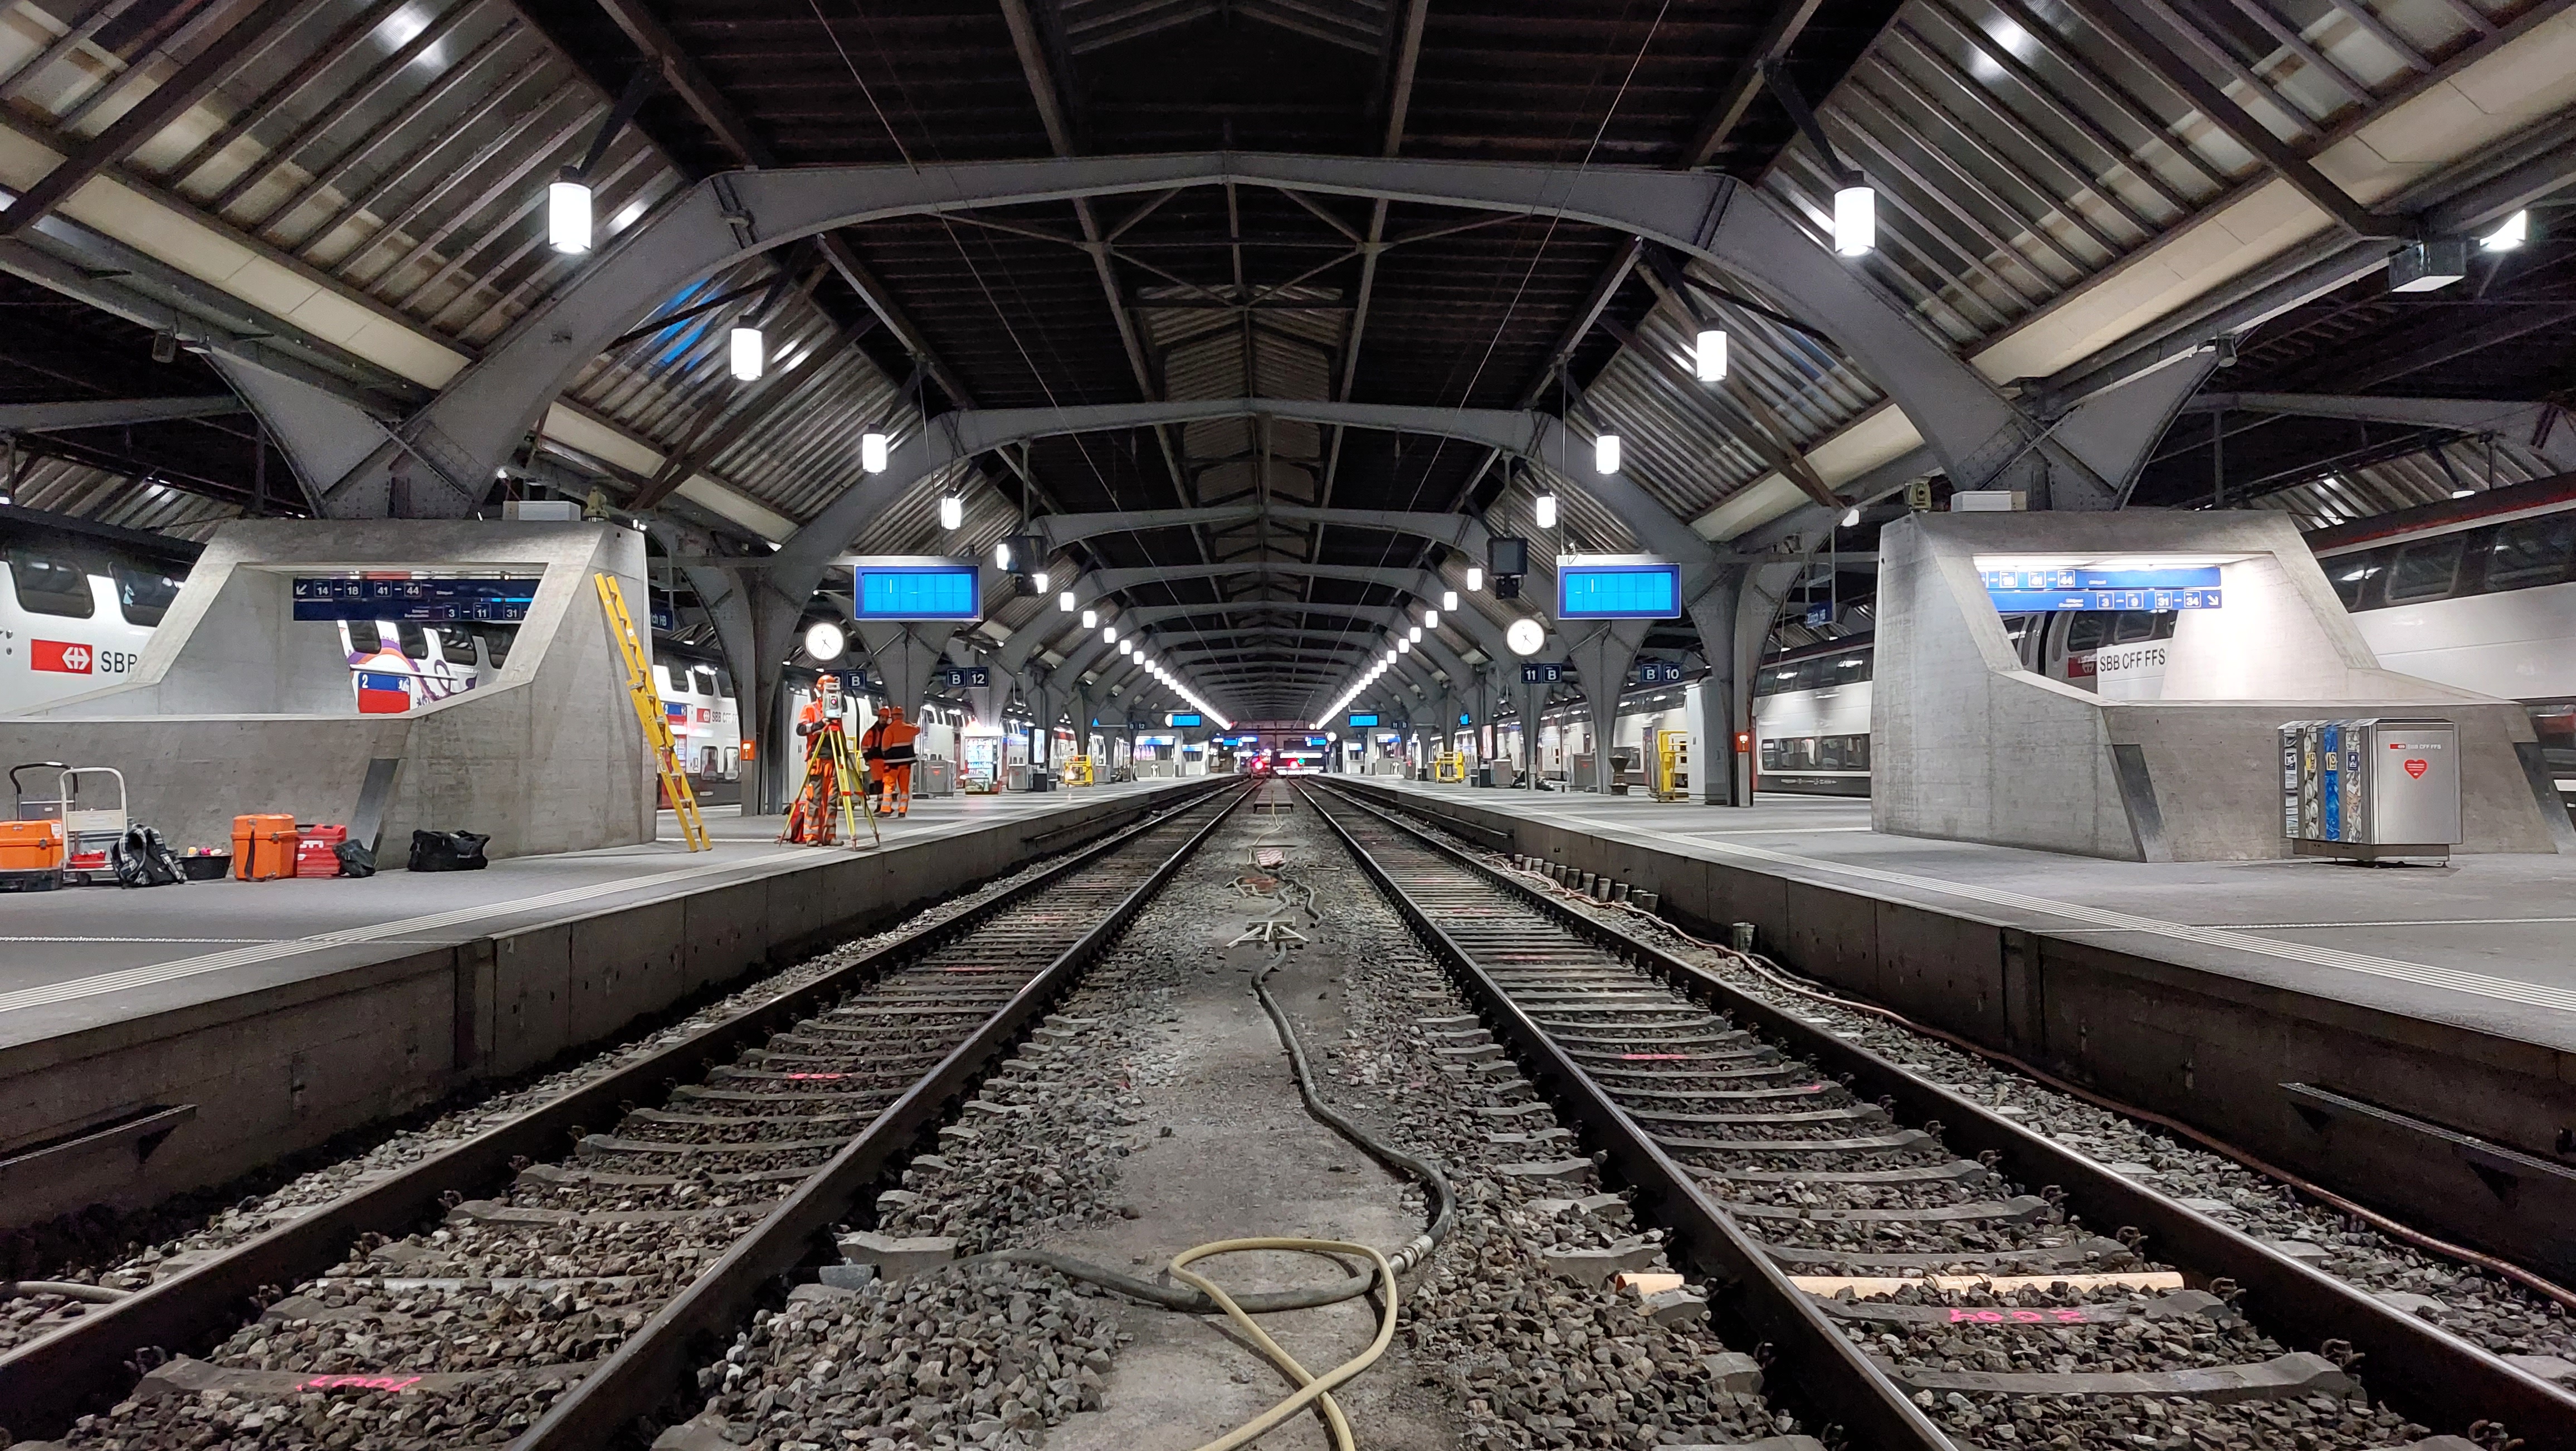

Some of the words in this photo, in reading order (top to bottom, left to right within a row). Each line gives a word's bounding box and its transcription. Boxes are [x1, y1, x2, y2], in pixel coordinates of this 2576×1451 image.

[316, 586, 329, 595] 14
[347, 586, 359, 595] 18
[377, 586, 388, 595] 41
[407, 586, 419, 595] 44
[2101, 597, 2110, 607] 3
[2131, 597, 2139, 607] 9
[2157, 597, 2169, 606] 31
[2186, 596, 2199, 606] 34
[448, 609, 455, 617] 3
[477, 608, 487, 617] 11
[506, 609, 517, 618] 31
[2100, 654, 2120, 673] SBB
[2123, 651, 2142, 669] CFF
[2145, 648, 2165, 667] FFS
[952, 674, 961, 685] B
[972, 674, 985, 684] 12
[1526, 670, 1536, 680] 11
[1548, 670, 1557, 680] B
[1646, 669, 1656, 680] B
[1666, 669, 1679, 679] 10
[362, 674, 368, 689] 2
[851, 676, 860, 686] B
[664, 704, 669, 715] 2
[712, 711, 721, 723] SBB
